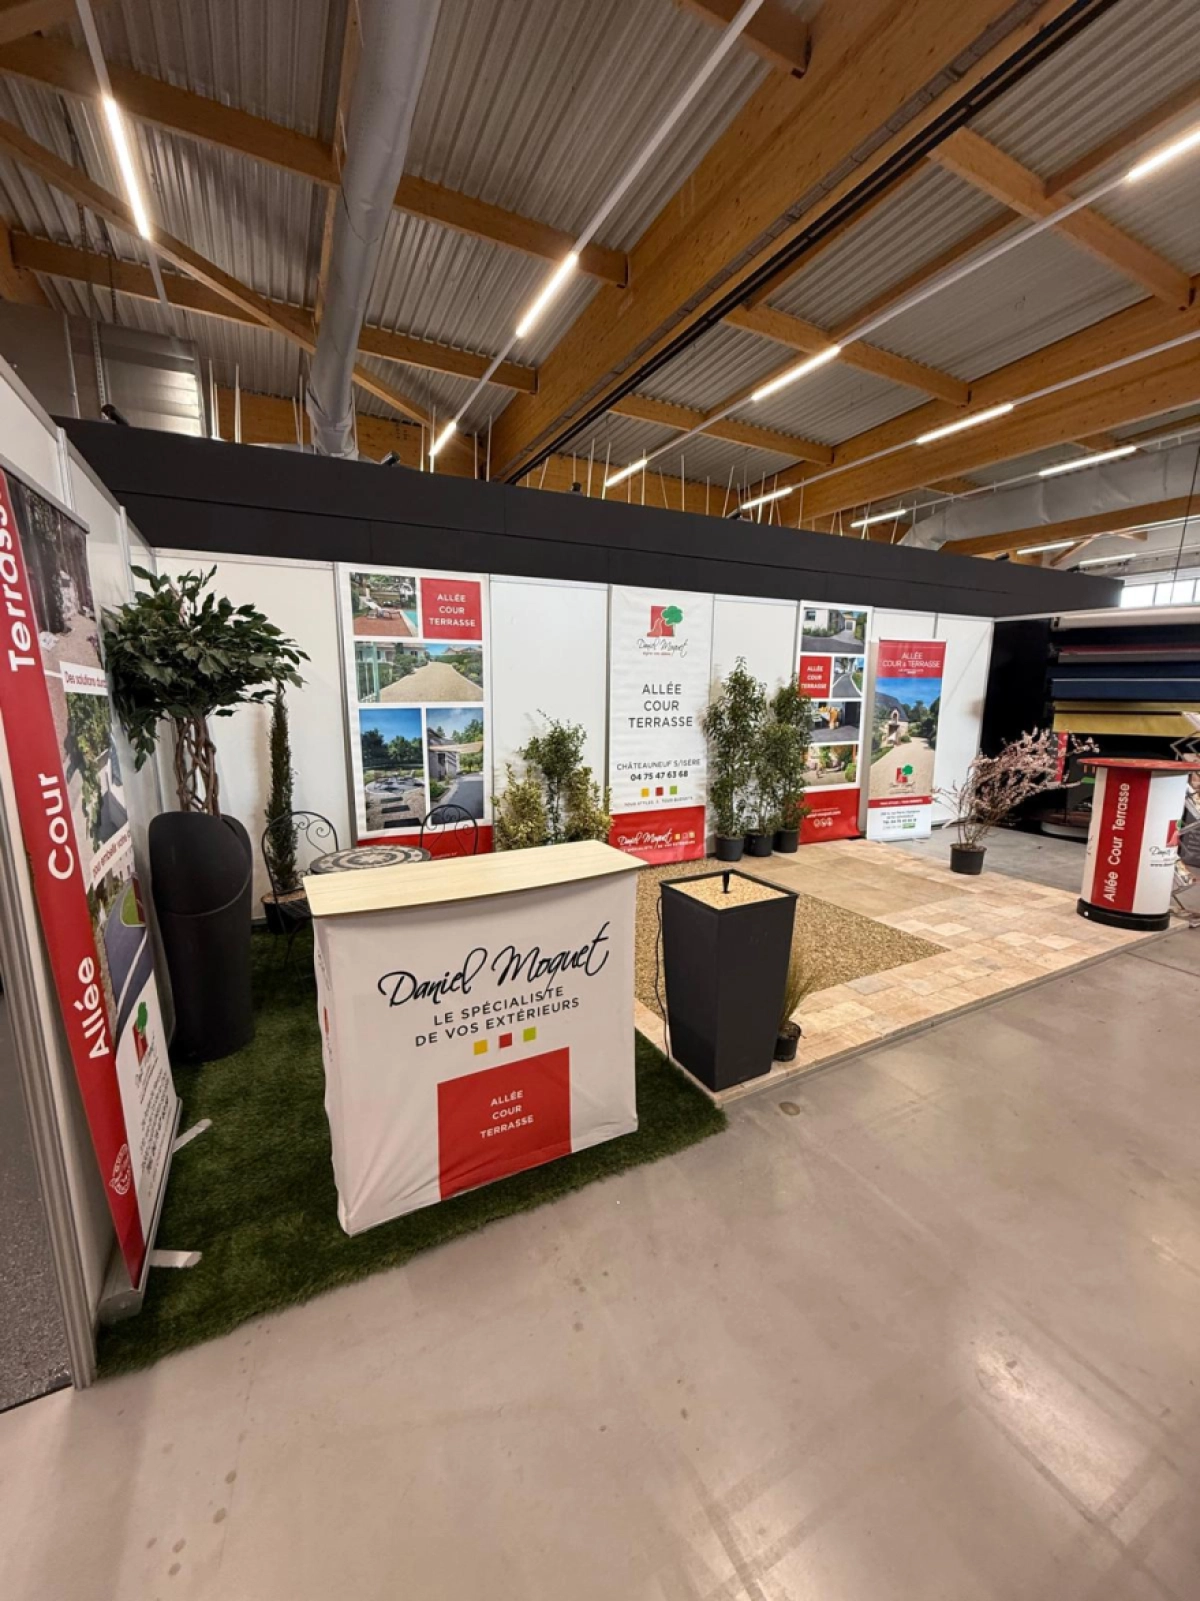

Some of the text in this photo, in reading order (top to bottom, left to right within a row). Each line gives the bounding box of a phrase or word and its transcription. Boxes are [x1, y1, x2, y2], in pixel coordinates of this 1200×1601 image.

[437, 593, 466, 603] ALLÉE
[439, 606, 465, 615] COUR
[429, 617, 476, 627] TERRASSE
[882, 660, 902, 668] COUR
[908, 660, 941, 668] TERRASSE
[642, 681, 682, 695] ALLÉE
[643, 700, 680, 712] COUR
[628, 716, 693, 728] TERRASSE
[616, 759, 671, 771] CHÂTEAUNEUF
[0, 492, 109, 1059] Allée Cour Terras
[630, 773, 642, 781] 04
[643, 771, 654, 780] 75
[655, 771, 665, 779] 47
[678, 769, 689, 778] 68
[1103, 783, 1131, 902] Allée Cour Terrasse
[377, 947, 488, 1007] Daniel
[491, 921, 610, 1000] Moquet
[434, 986, 564, 1026] LE SPÉCIALISTE
[415, 997, 580, 1047] DE VOS EXTÉRIEURS
[490, 1089, 524, 1107] ALLÉE
[492, 1104, 522, 1120] COUR
[480, 1114, 534, 1139] TERRASSE
